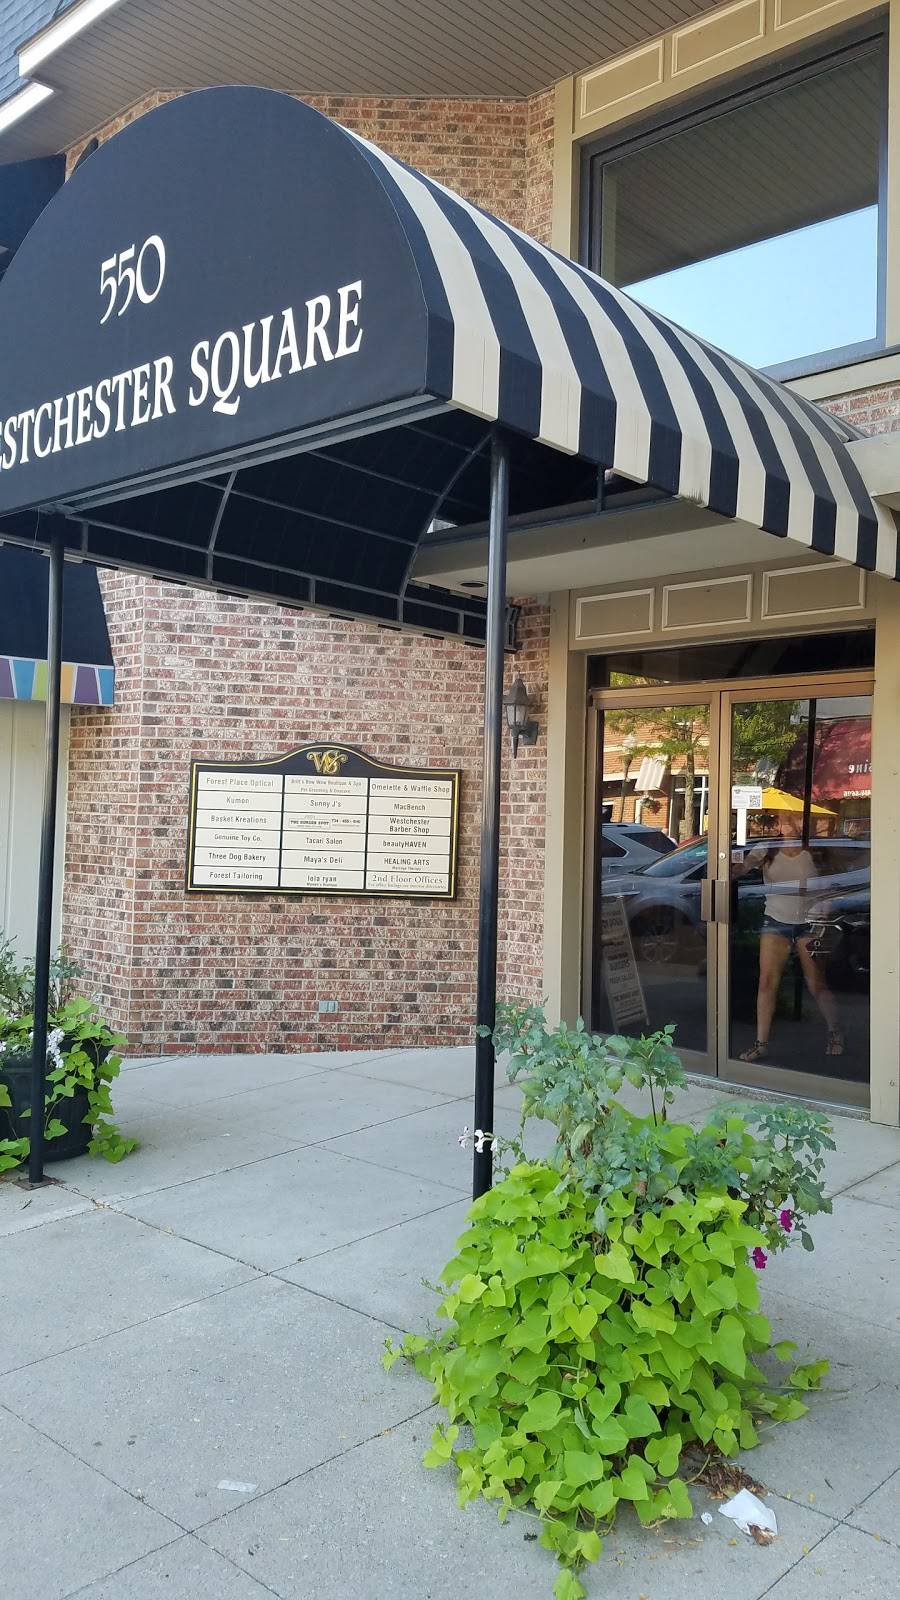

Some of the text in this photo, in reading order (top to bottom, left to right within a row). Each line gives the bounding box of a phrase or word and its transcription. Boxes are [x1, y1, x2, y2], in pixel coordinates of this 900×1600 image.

[100, 234, 166, 324] 550
[188, 279, 363, 416] SQUARE
[250, 779, 274, 788] Optical
[310, 800, 330, 808] Sunny
[413, 826, 430, 834] Shop
[382, 840, 427, 848] beautyHAVEN
[229, 853, 242, 862] Dog
[244, 853, 266, 862] Bakery
[303, 856, 327, 864] Maya's
[233, 872, 263, 880] Tailoring
[414, 876, 443, 884] Offices
